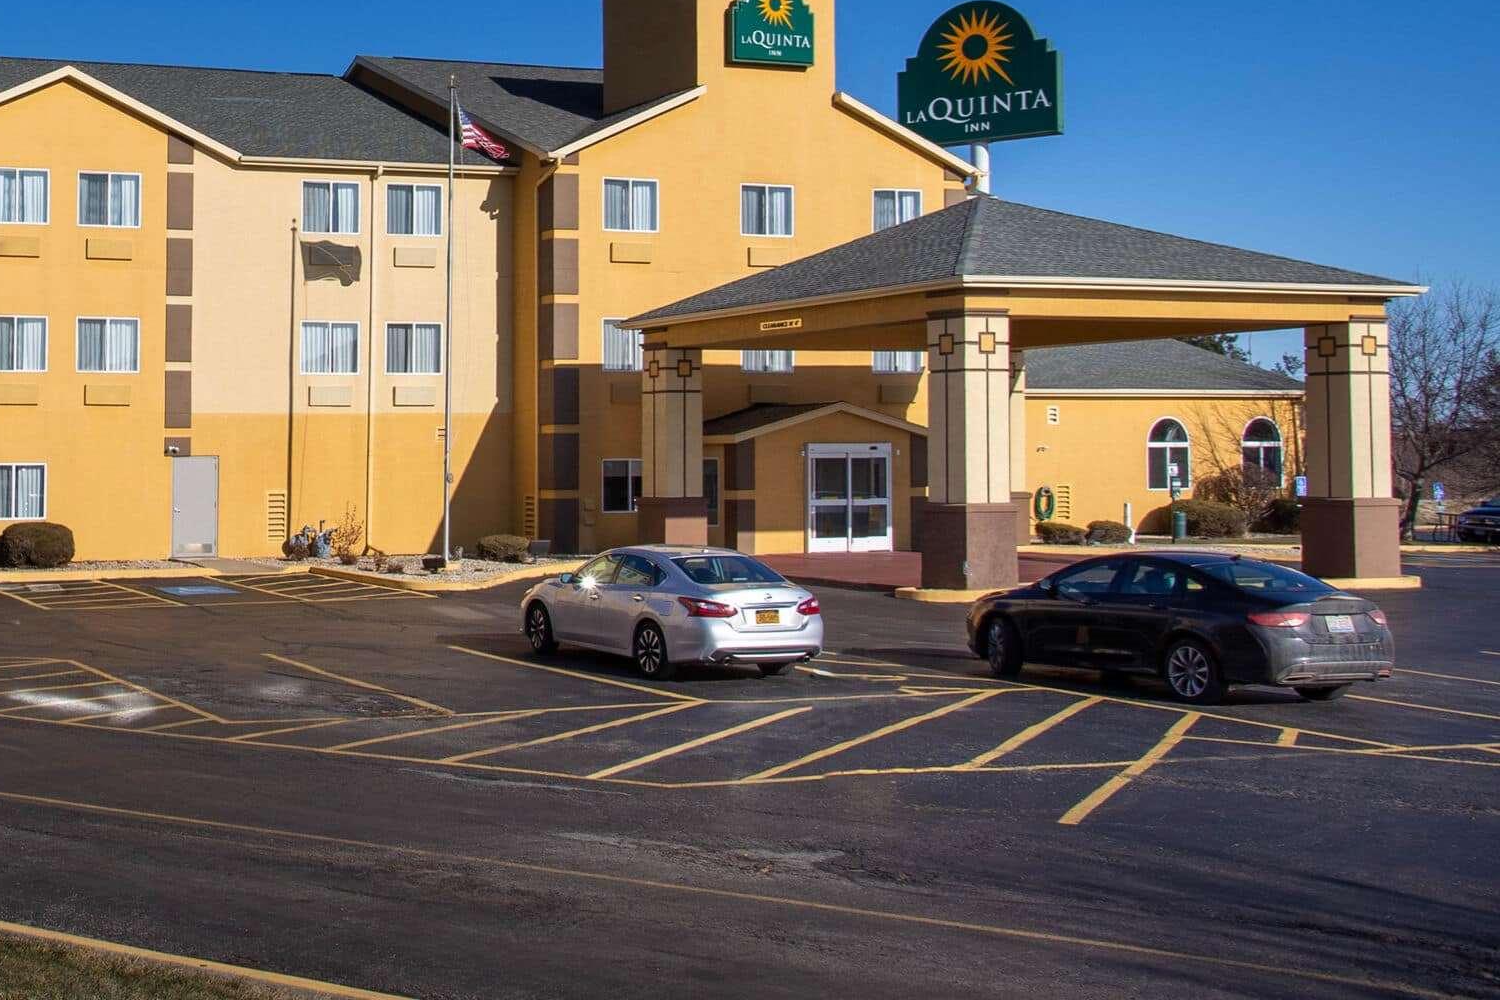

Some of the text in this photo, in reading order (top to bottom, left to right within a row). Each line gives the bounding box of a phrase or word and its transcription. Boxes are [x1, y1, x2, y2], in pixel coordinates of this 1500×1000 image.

[741, 30, 810, 48] LA QUINTA
[906, 88, 1052, 124] LA QUINTA
[964, 121, 991, 133] INN
